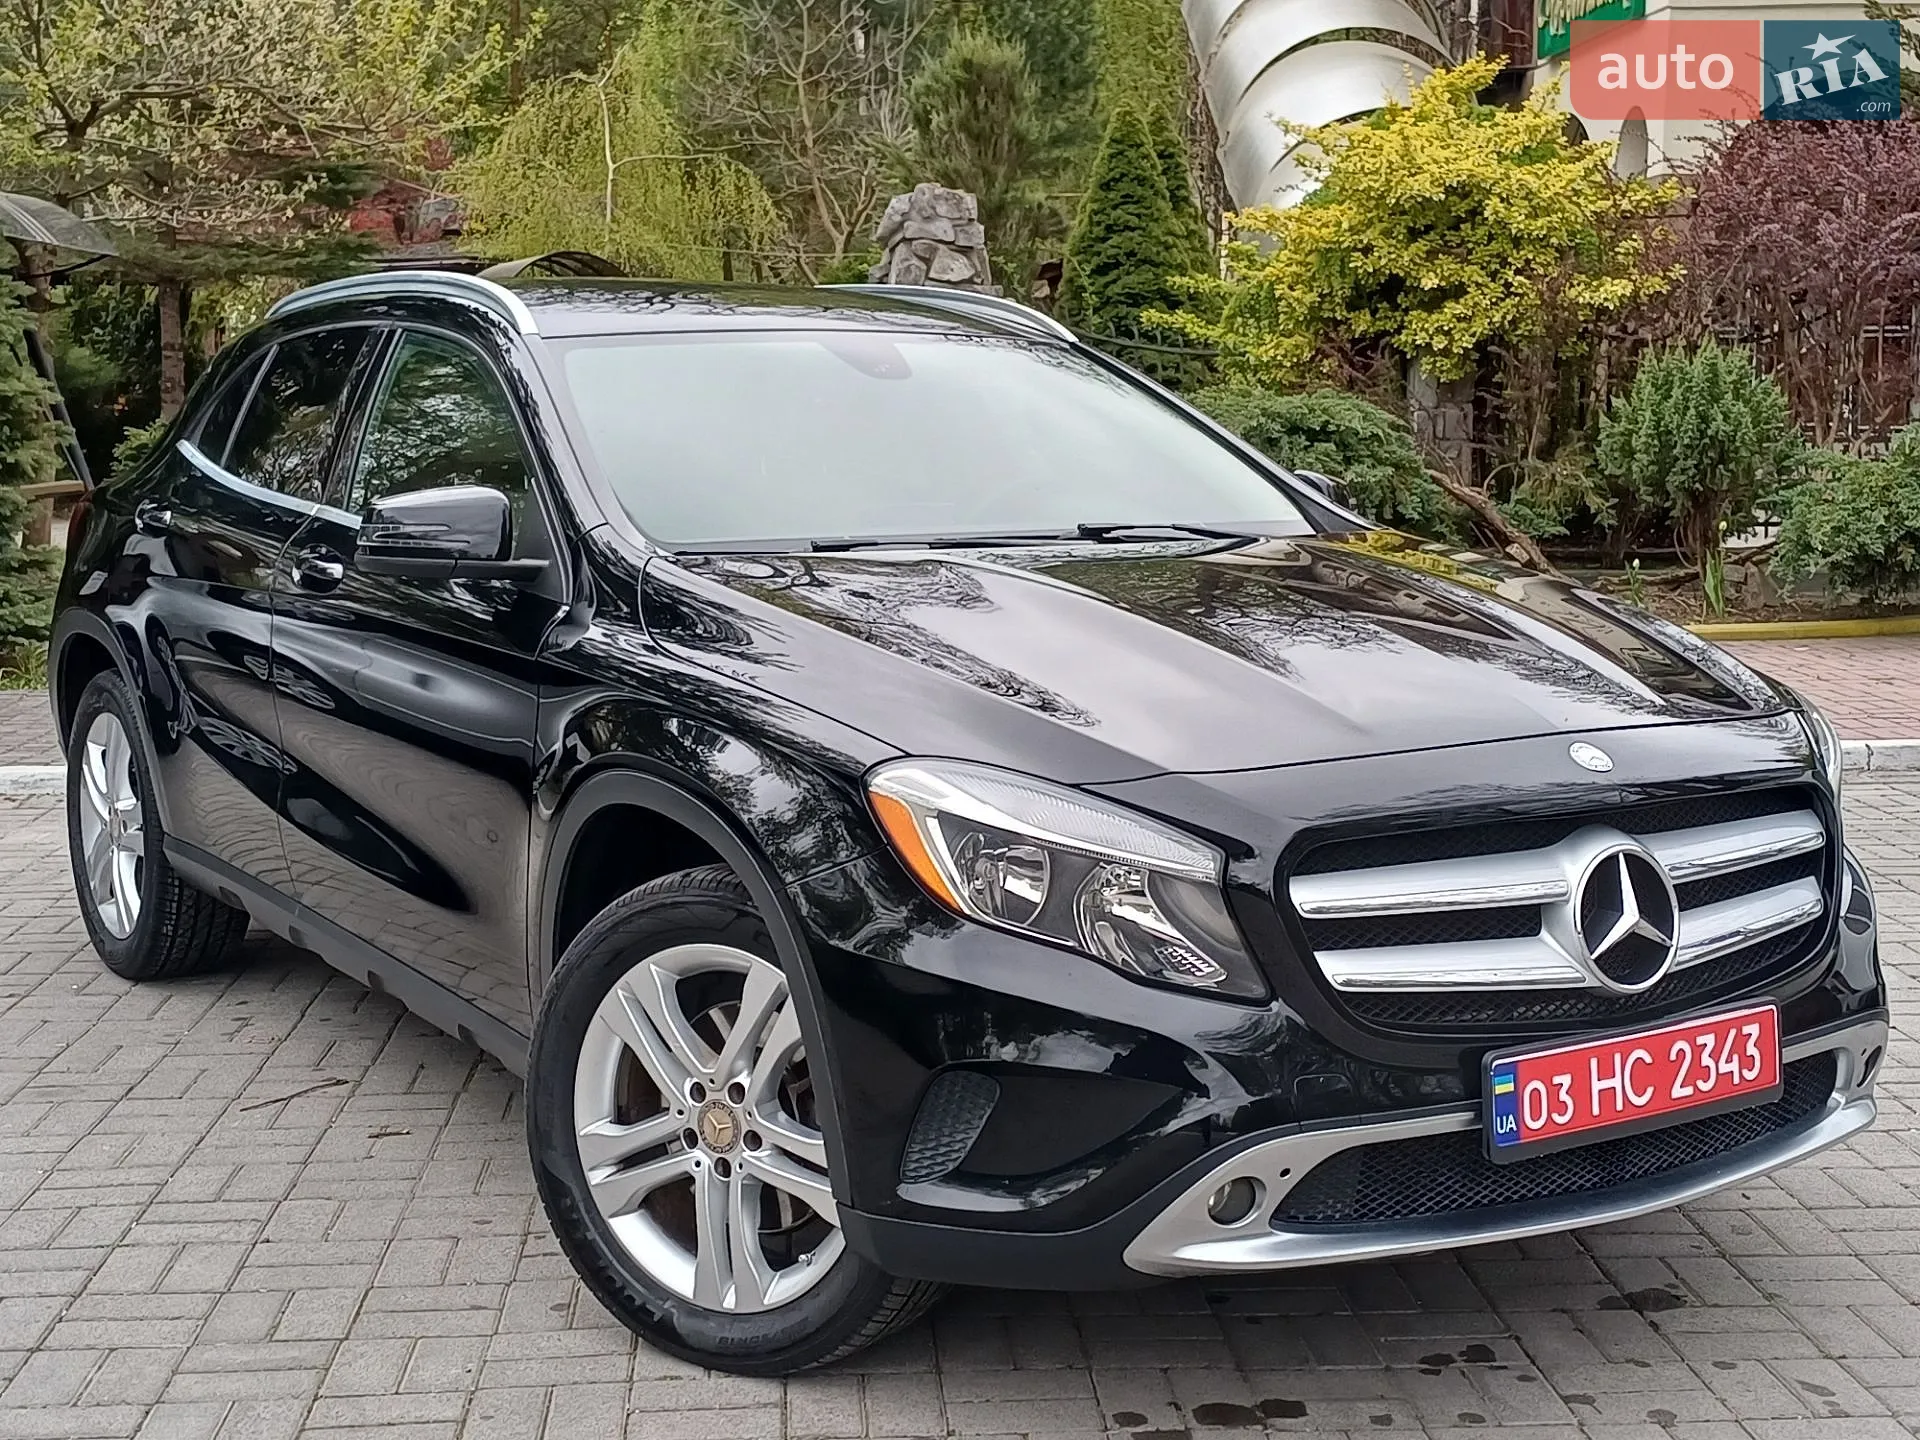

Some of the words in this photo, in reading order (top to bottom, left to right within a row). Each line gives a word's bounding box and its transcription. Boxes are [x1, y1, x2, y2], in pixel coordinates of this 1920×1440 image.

[1522, 1073, 1575, 1131] 03
[1589, 1048, 1655, 1117] HC
[1668, 1022, 1761, 1100] 2343
[1496, 1113, 1517, 1134] UA
